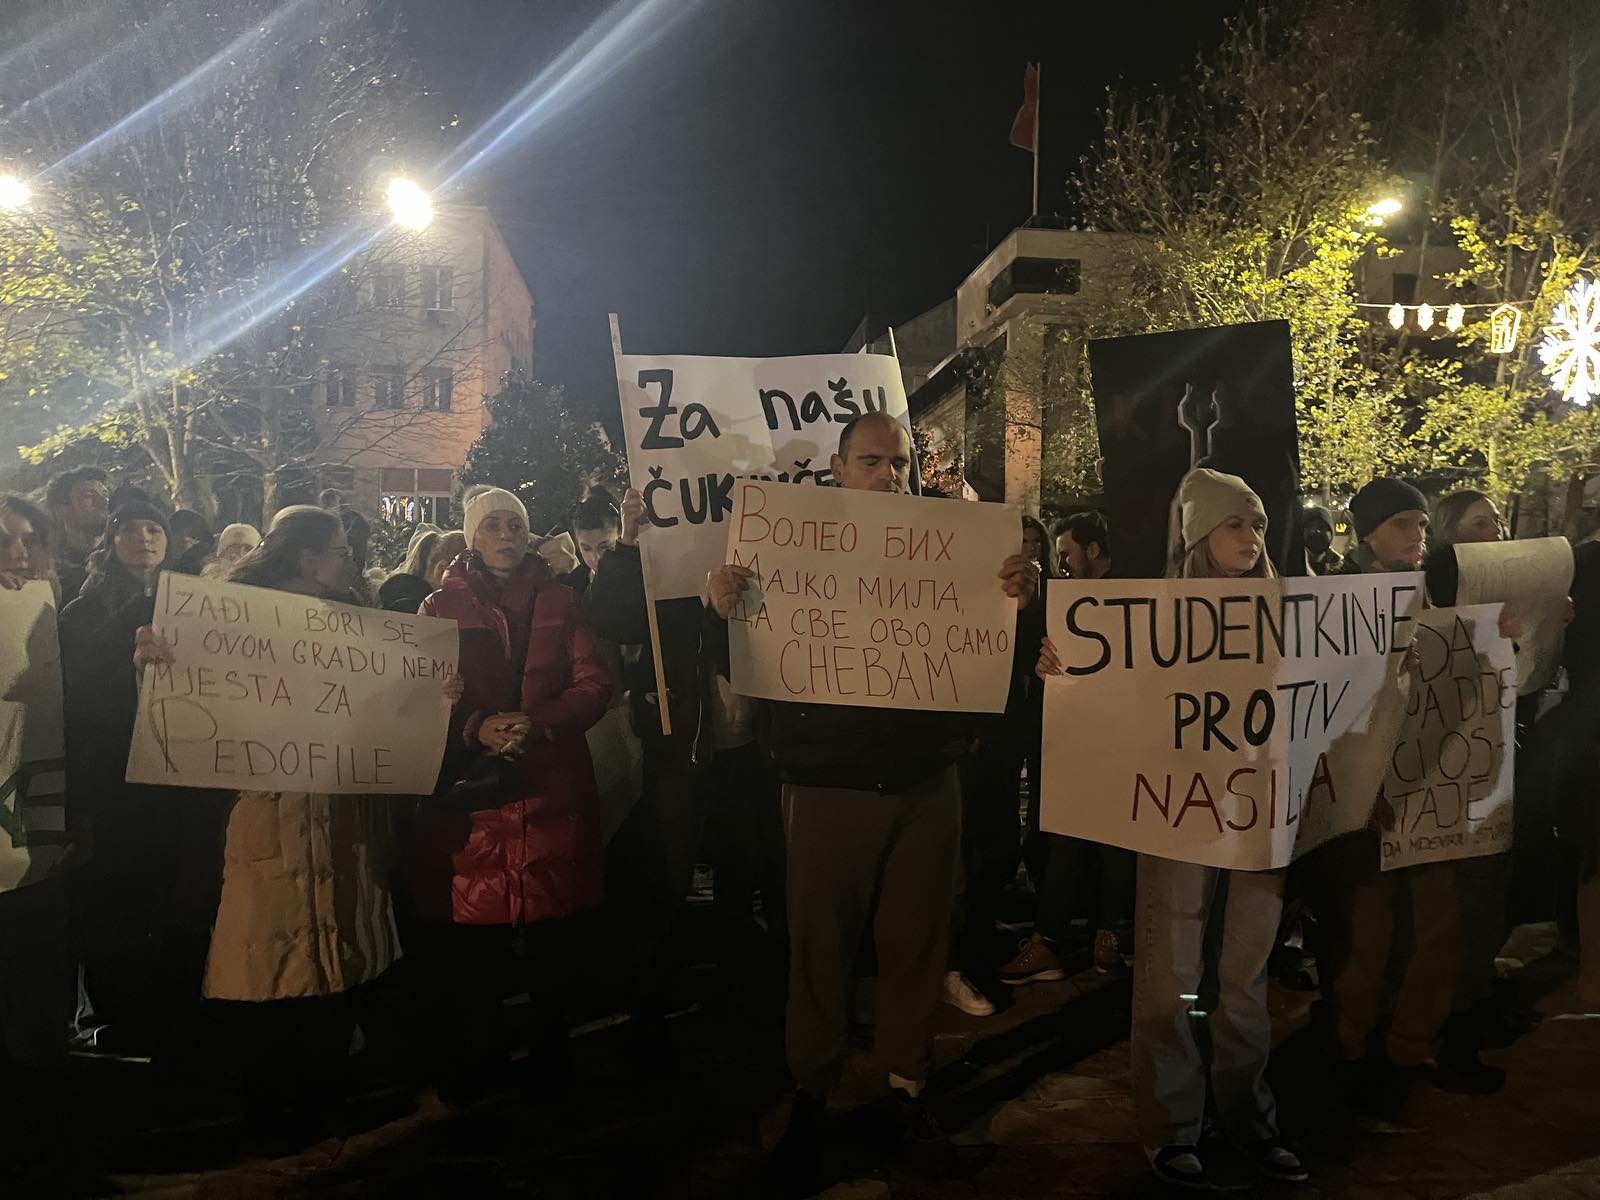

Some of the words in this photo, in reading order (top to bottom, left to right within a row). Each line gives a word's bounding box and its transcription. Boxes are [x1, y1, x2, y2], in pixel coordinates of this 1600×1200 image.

[638, 368, 721, 450] Za
[885, 527, 954, 562] БИХ
[859, 577, 965, 616] МИЛА,
[275, 605, 281, 628] I
[305, 608, 365, 638] BORI
[383, 620, 419, 648] SE.
[791, 608, 850, 640] СВЕ
[870, 618, 931, 647] ОВО
[946, 625, 1008, 656] САМО
[203, 629, 276, 665] OVOM
[292, 639, 386, 677] GRADU
[402, 656, 454, 681] NEMA
[780, 639, 959, 704] СНЕВАМ
[152, 656, 292, 706] MJESTA
[315, 682, 351, 717] ZA
[1168, 680, 1350, 752] PROTIV
